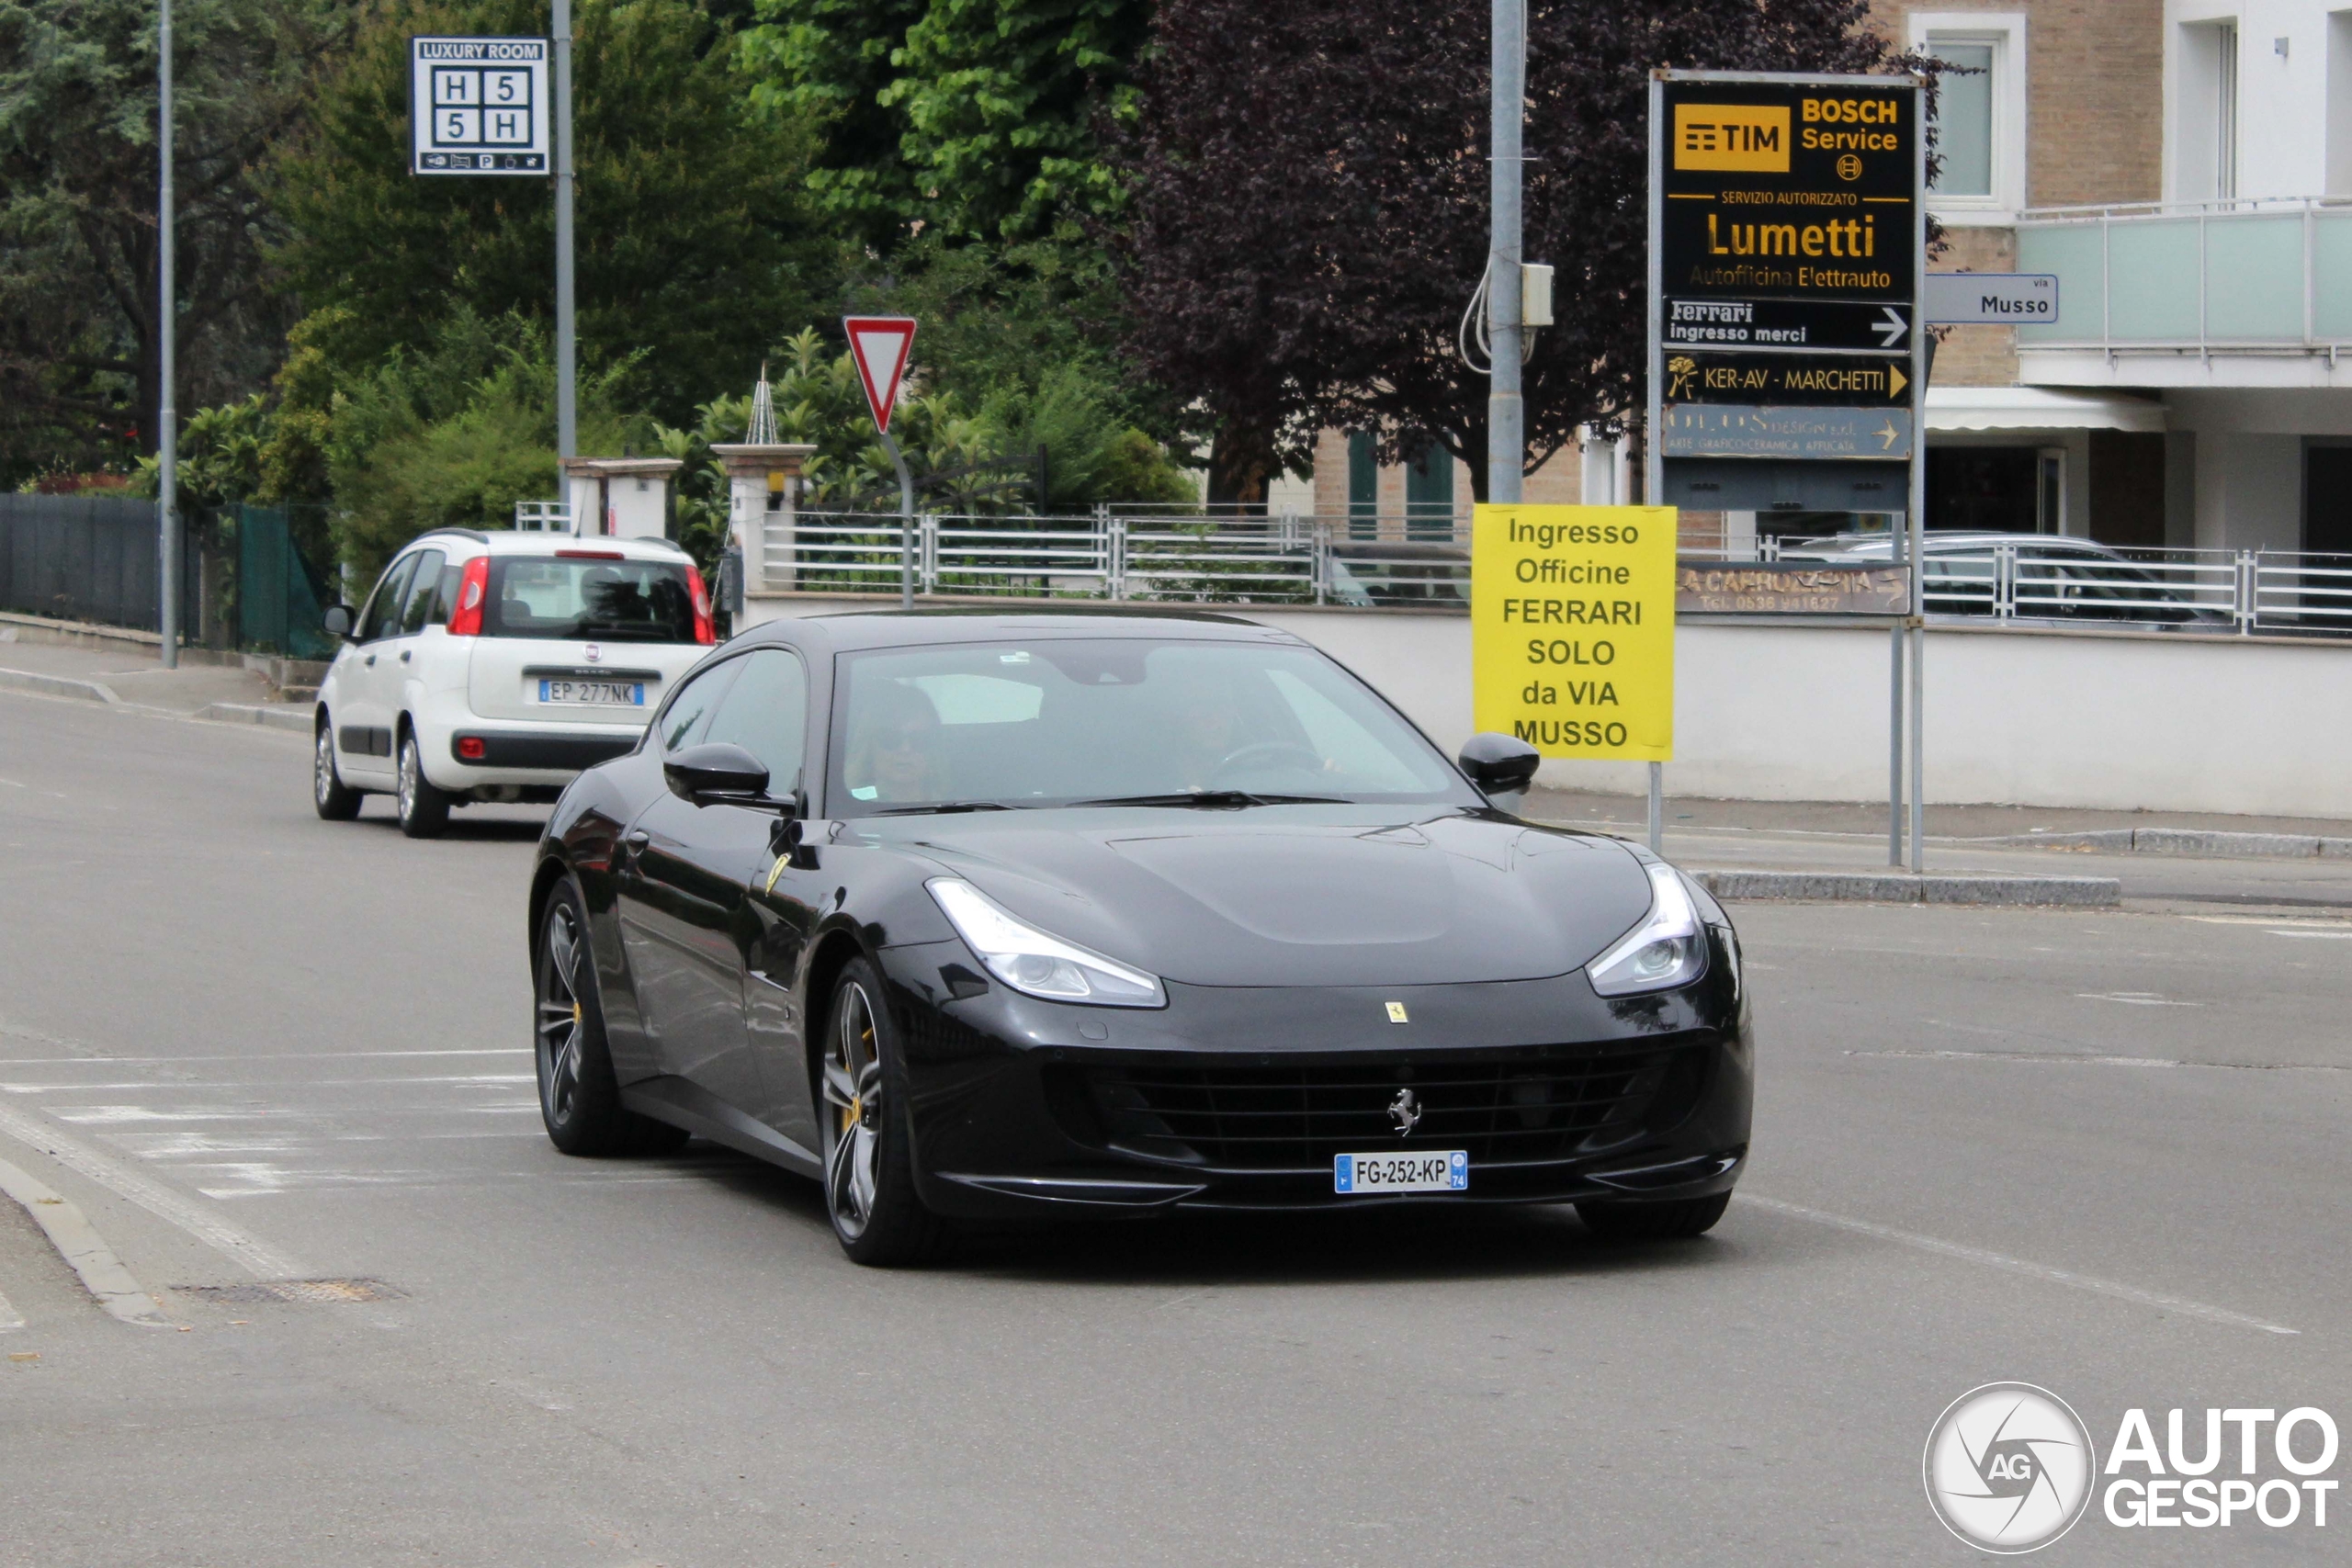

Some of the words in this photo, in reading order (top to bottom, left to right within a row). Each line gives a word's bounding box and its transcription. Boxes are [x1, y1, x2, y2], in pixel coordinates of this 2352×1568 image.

[424, 43, 485, 58] LUXURY
[488, 44, 538, 59] ROOM
[447, 75, 466, 100] H
[497, 75, 514, 101] 5
[1802, 98, 1897, 124] BOSCH
[447, 113, 465, 139] 5
[496, 114, 515, 138] H
[1722, 125, 1779, 152] TIM
[1802, 128, 1898, 151] Service
[1722, 191, 1774, 205] SERVIZIO
[1777, 192, 1857, 206] AUTORIZZATO
[1707, 213, 1874, 257] Lumetti
[1798, 266, 1891, 288] Elettrauto
[2033, 278, 2049, 288] via
[1670, 300, 1753, 322] Ferrari
[1982, 296, 2048, 313] Musso
[1669, 322, 1747, 343] ingresso
[1755, 326, 1806, 343] merci
[1705, 367, 1768, 389] KER-AV
[1785, 369, 1883, 390] MARCHETTI
[1510, 518, 1639, 549] Ingresso
[1516, 558, 1630, 584] Officine
[1503, 598, 1641, 626] FERRARI
[1736, 595, 1776, 610] 0536
[1526, 639, 1615, 665] SOLO
[551, 682, 572, 700] EP
[579, 683, 632, 703] 277NK
[1522, 681, 1557, 705] da
[1567, 682, 1619, 705] VIA
[1513, 720, 1628, 747] MUSSO
[1357, 1159, 1446, 1184] FG-252-KP
[1452, 1175, 1464, 1187] 74
